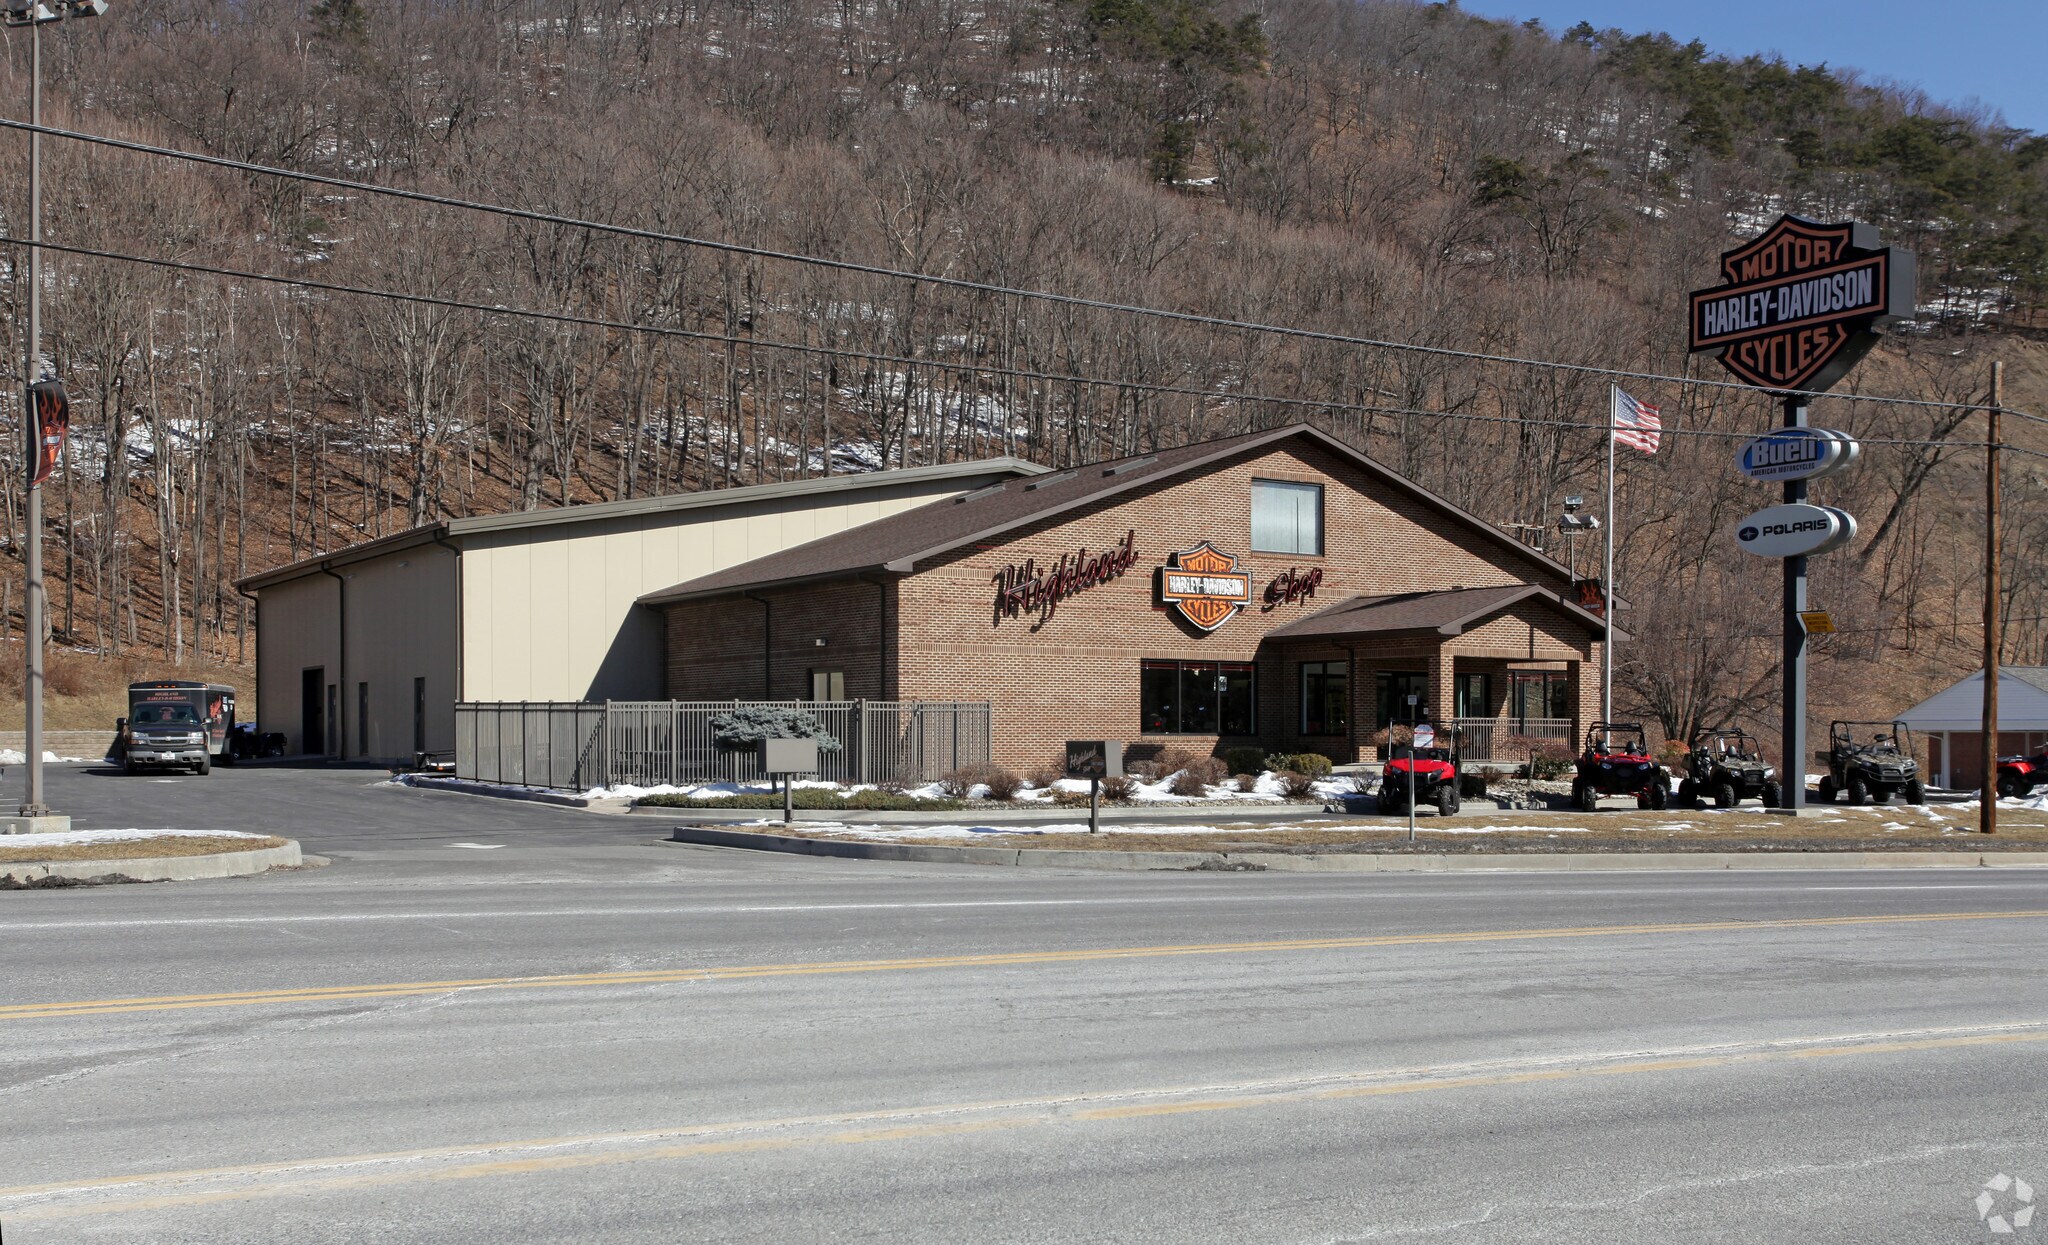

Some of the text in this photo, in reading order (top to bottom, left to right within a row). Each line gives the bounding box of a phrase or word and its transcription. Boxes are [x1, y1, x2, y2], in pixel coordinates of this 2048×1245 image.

[1742, 233, 1831, 282] MOTOR
[1704, 268, 1873, 336] HARLEY-DAVIDSON
[1740, 326, 1831, 381] CYCLES
[1752, 435, 1816, 467] Buell
[1751, 462, 1815, 476] AMERICAN MOTORCYCLES
[1763, 518, 1828, 537] POLARIS
[1001, 529, 1322, 623] Highland Shop
[1186, 553, 1227, 572] MOTOR
[1168, 575, 1245, 596] HARLEY-DAVIDSON
[1186, 599, 1227, 622] CYCLES
